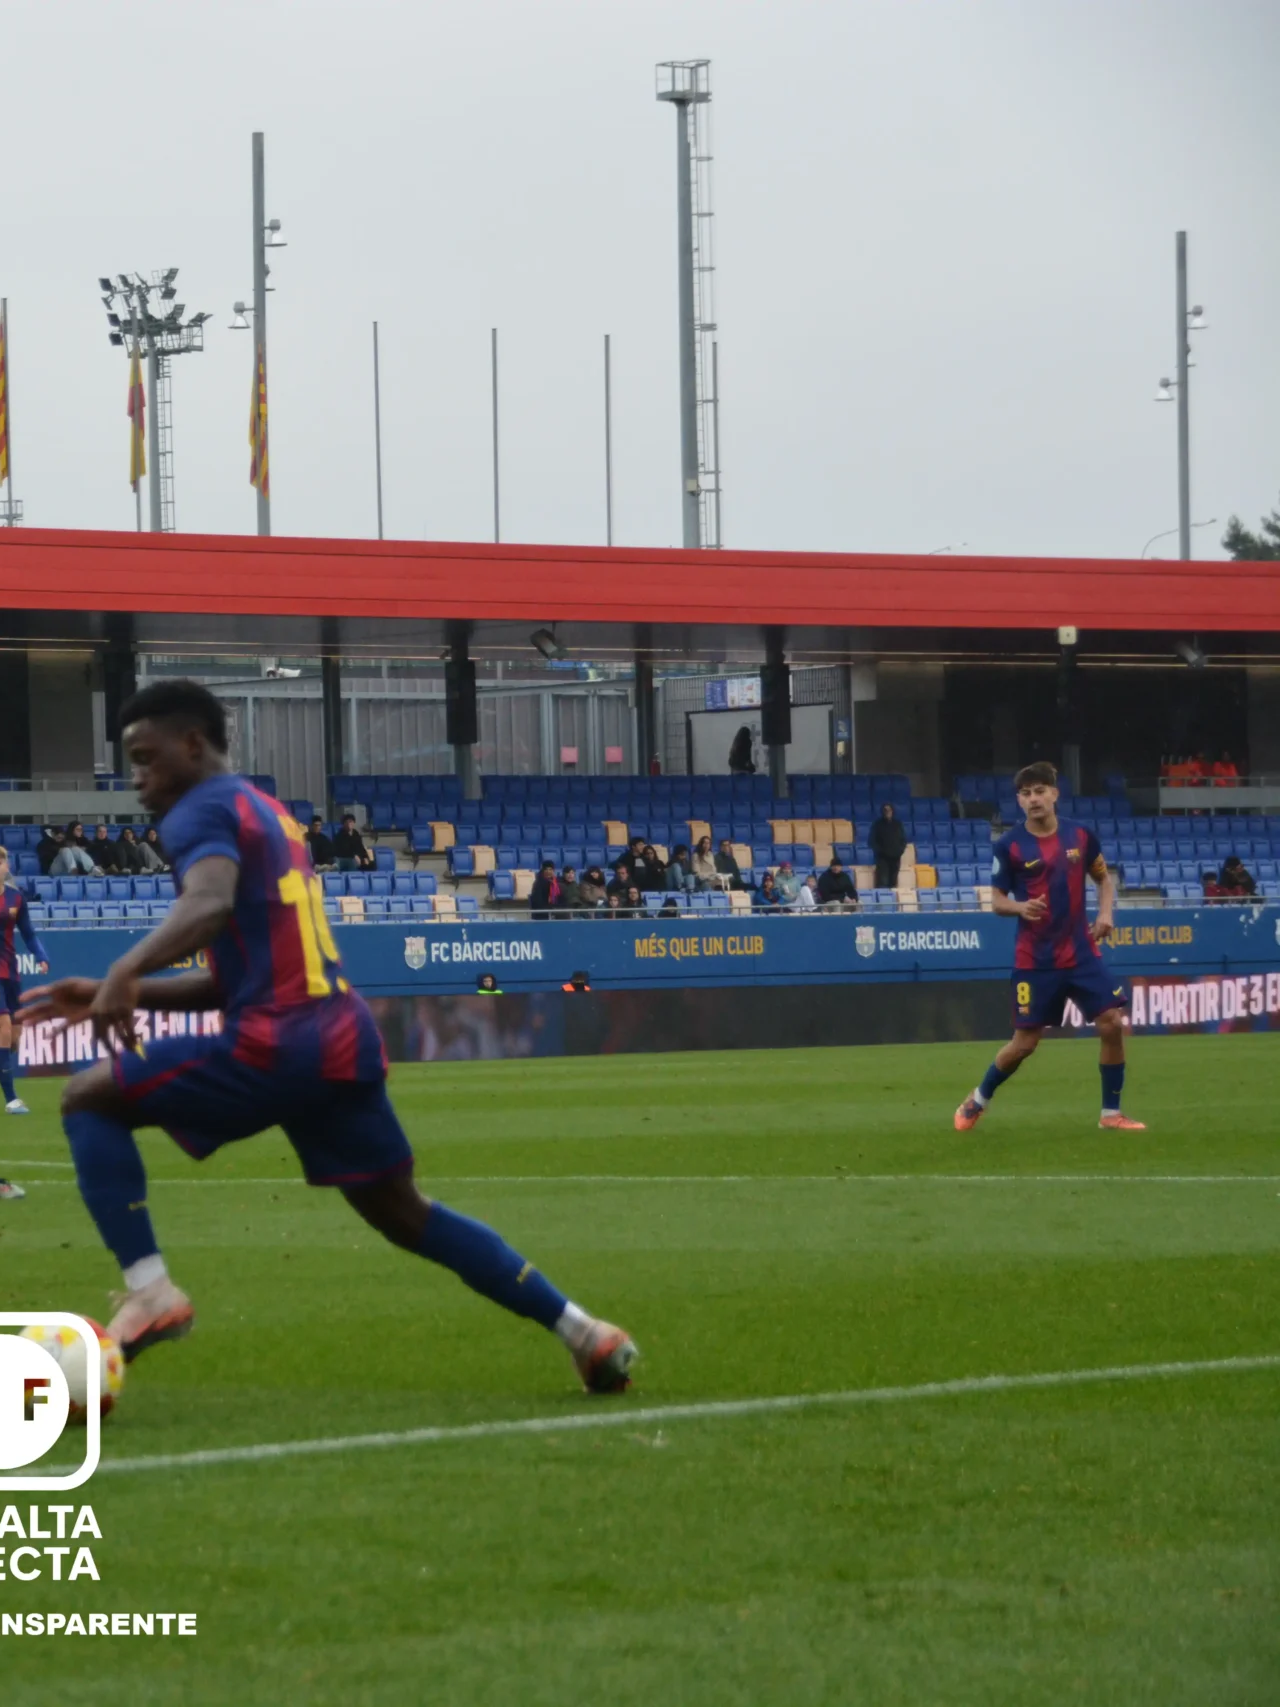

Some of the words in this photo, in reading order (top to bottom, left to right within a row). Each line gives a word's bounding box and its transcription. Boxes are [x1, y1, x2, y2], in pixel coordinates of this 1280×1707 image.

[635, 932, 667, 958] MÉS
[670, 937, 700, 960] QUE
[703, 937, 724, 956] UN
[727, 935, 764, 955] CLUB
[879, 932, 896, 951] FC
[898, 931, 980, 950] BARCELONA
[1135, 927, 1155, 945] UN
[1158, 925, 1193, 944] CLUB
[431, 943, 449, 962] FC
[452, 941, 542, 962] BARCELONA
[1017, 982, 1030, 1005] 8
[1132, 985, 1146, 1025] A
[1149, 982, 1219, 1025] PARTIR
[1222, 978, 1247, 1019] DE
[1249, 975, 1263, 1015] 3
[18, 1018, 94, 1066] ARTIR
